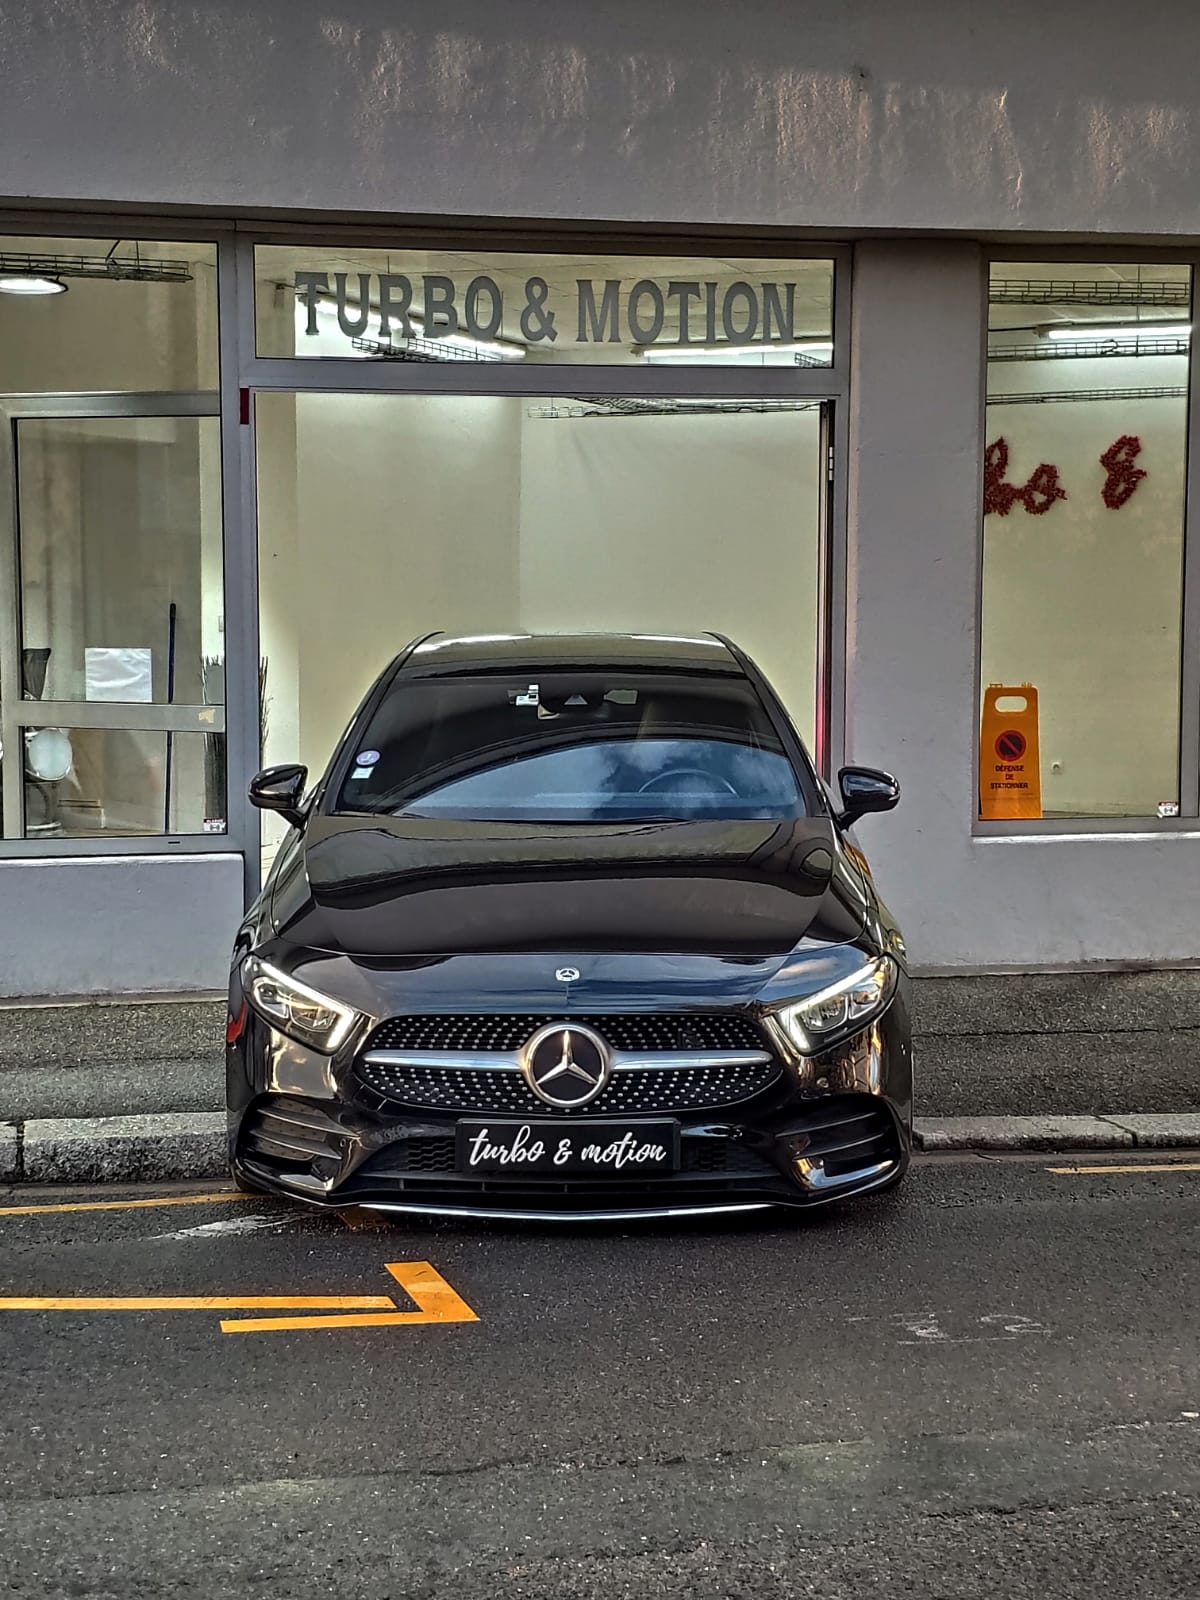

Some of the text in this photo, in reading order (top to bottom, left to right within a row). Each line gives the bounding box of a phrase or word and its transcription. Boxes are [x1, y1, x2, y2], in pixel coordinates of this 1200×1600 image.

[294, 272, 796, 344] TURBO & MOTION
[995, 764, 1024, 772] DÉFENSE
[469, 1125, 667, 1168] turbo & motion
